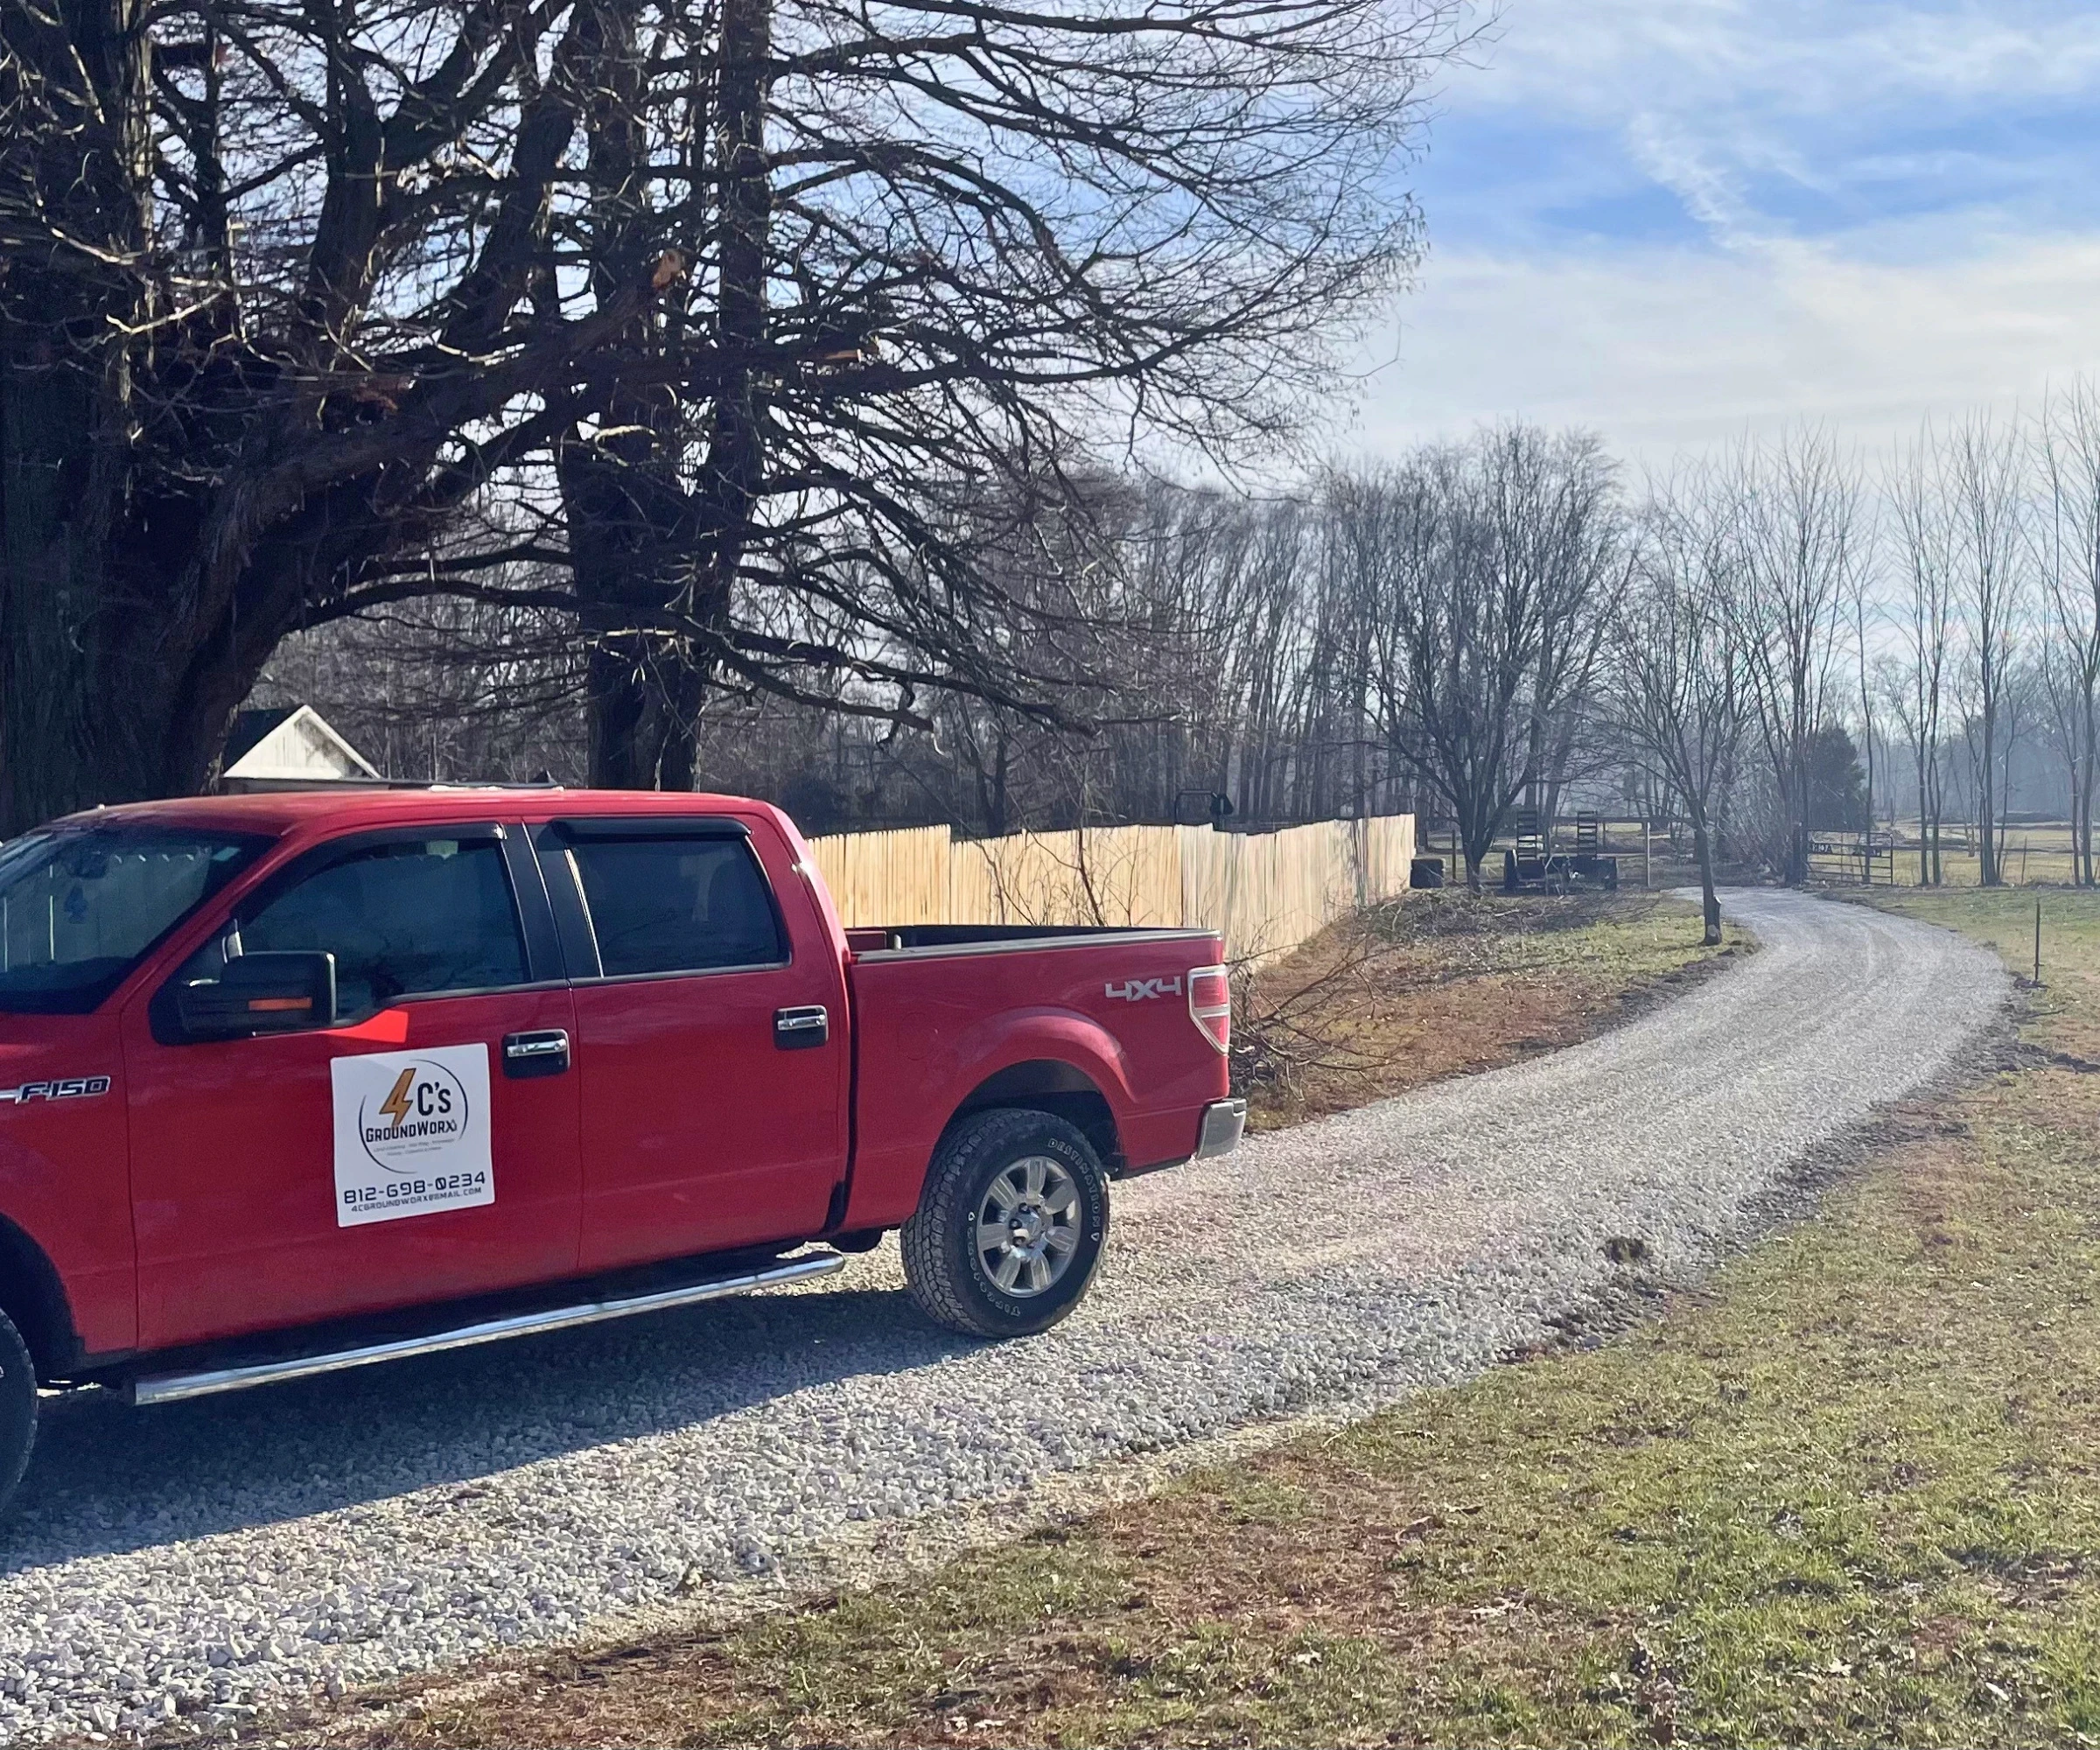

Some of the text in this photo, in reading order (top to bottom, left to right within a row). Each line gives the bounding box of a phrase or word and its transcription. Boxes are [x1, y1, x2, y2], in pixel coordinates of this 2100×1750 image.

[1105, 976, 1182, 1002] 4X4
[17, 1075, 110, 1104] F-150
[344, 1171, 486, 1204] 812-698-0234
[1048, 1138, 1102, 1228] DESTINATION
